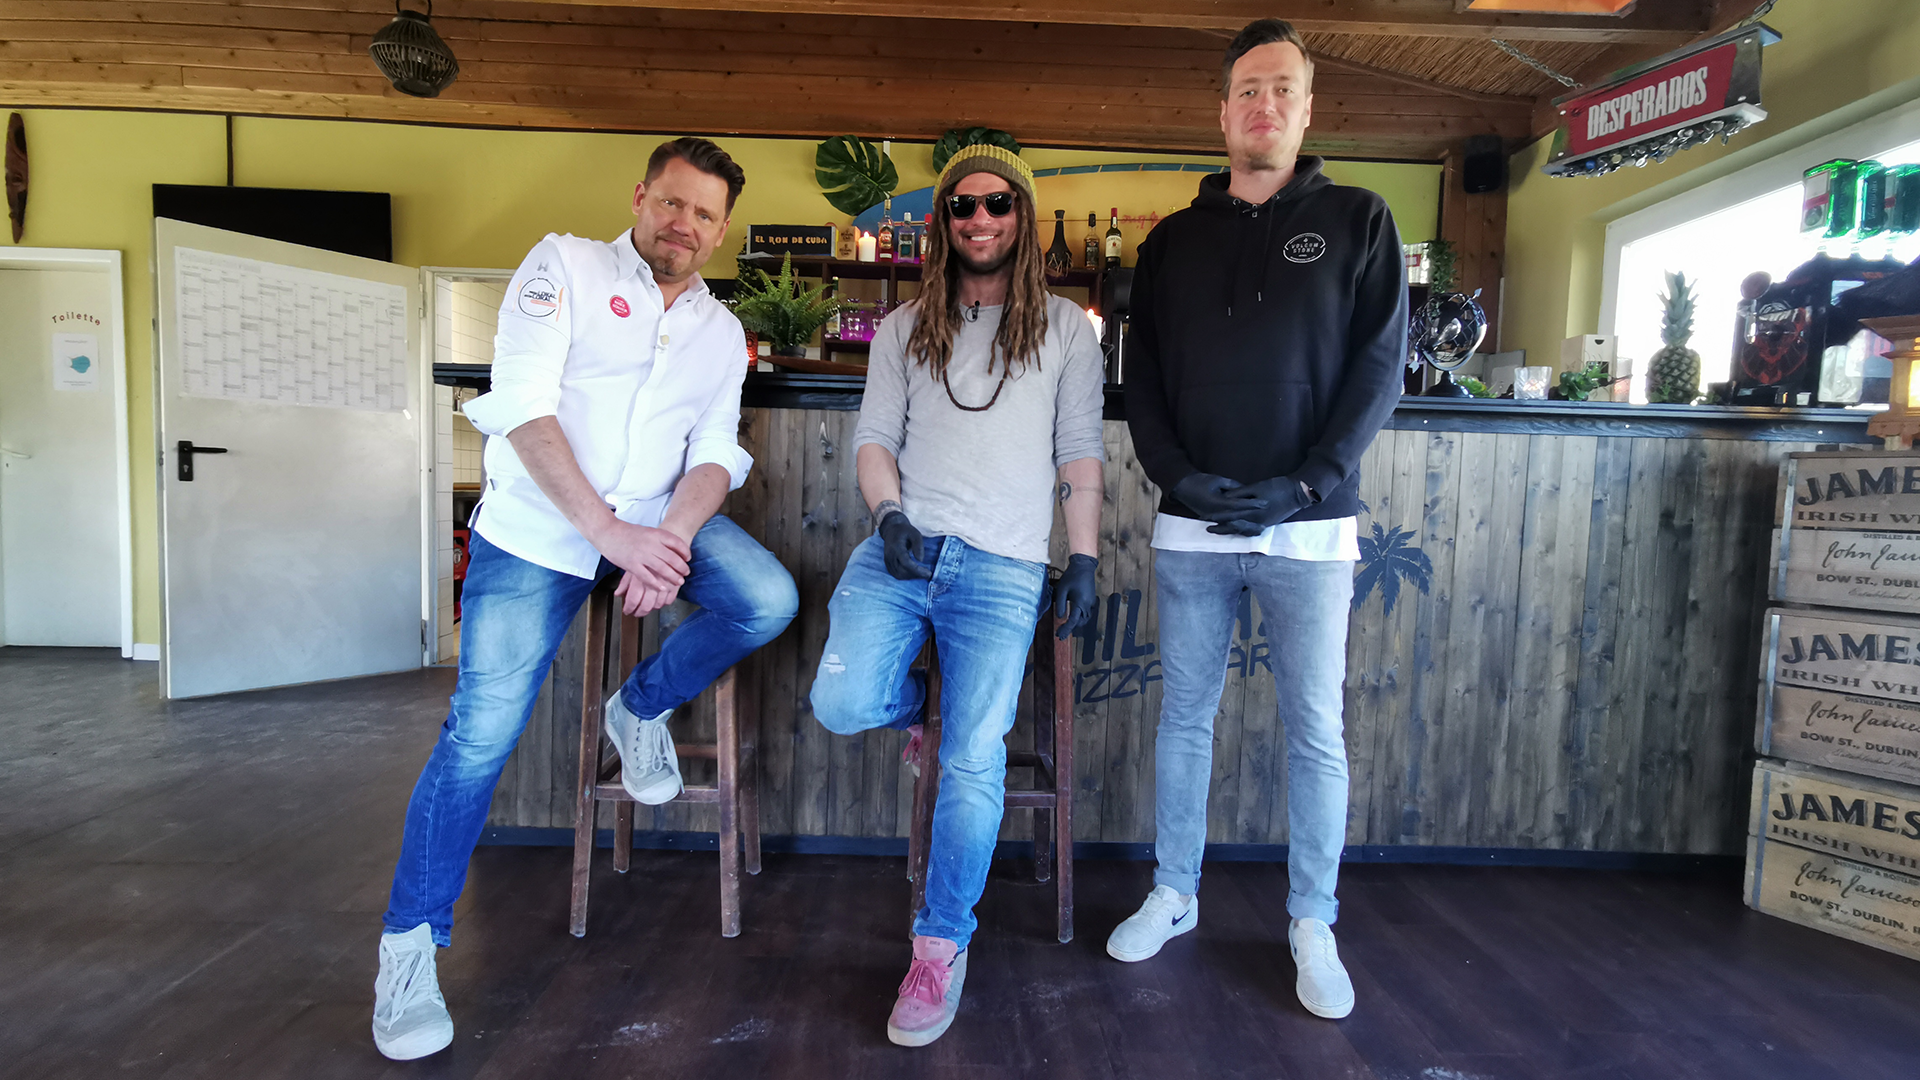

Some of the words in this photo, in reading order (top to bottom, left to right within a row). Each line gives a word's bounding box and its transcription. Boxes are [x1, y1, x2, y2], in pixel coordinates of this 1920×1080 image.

[1587, 66, 1708, 141] DESPERADOS
[755, 235, 765, 243] EL
[768, 236, 789, 245] RON
[792, 236, 803, 244] DE
[805, 236, 827, 244] CUBA
[52, 311, 100, 326] Toilette
[1797, 511, 1879, 523] IRISH
[1821, 541, 1871, 569] John
[1816, 574, 1851, 584] BOW
[1780, 668, 1860, 688] IRISH
[1805, 700, 1854, 727] John
[1800, 731, 1834, 744] BOW
[1772, 824, 1851, 853] IRISH
[1794, 861, 1842, 887] John
[1790, 890, 1824, 906] BOW
